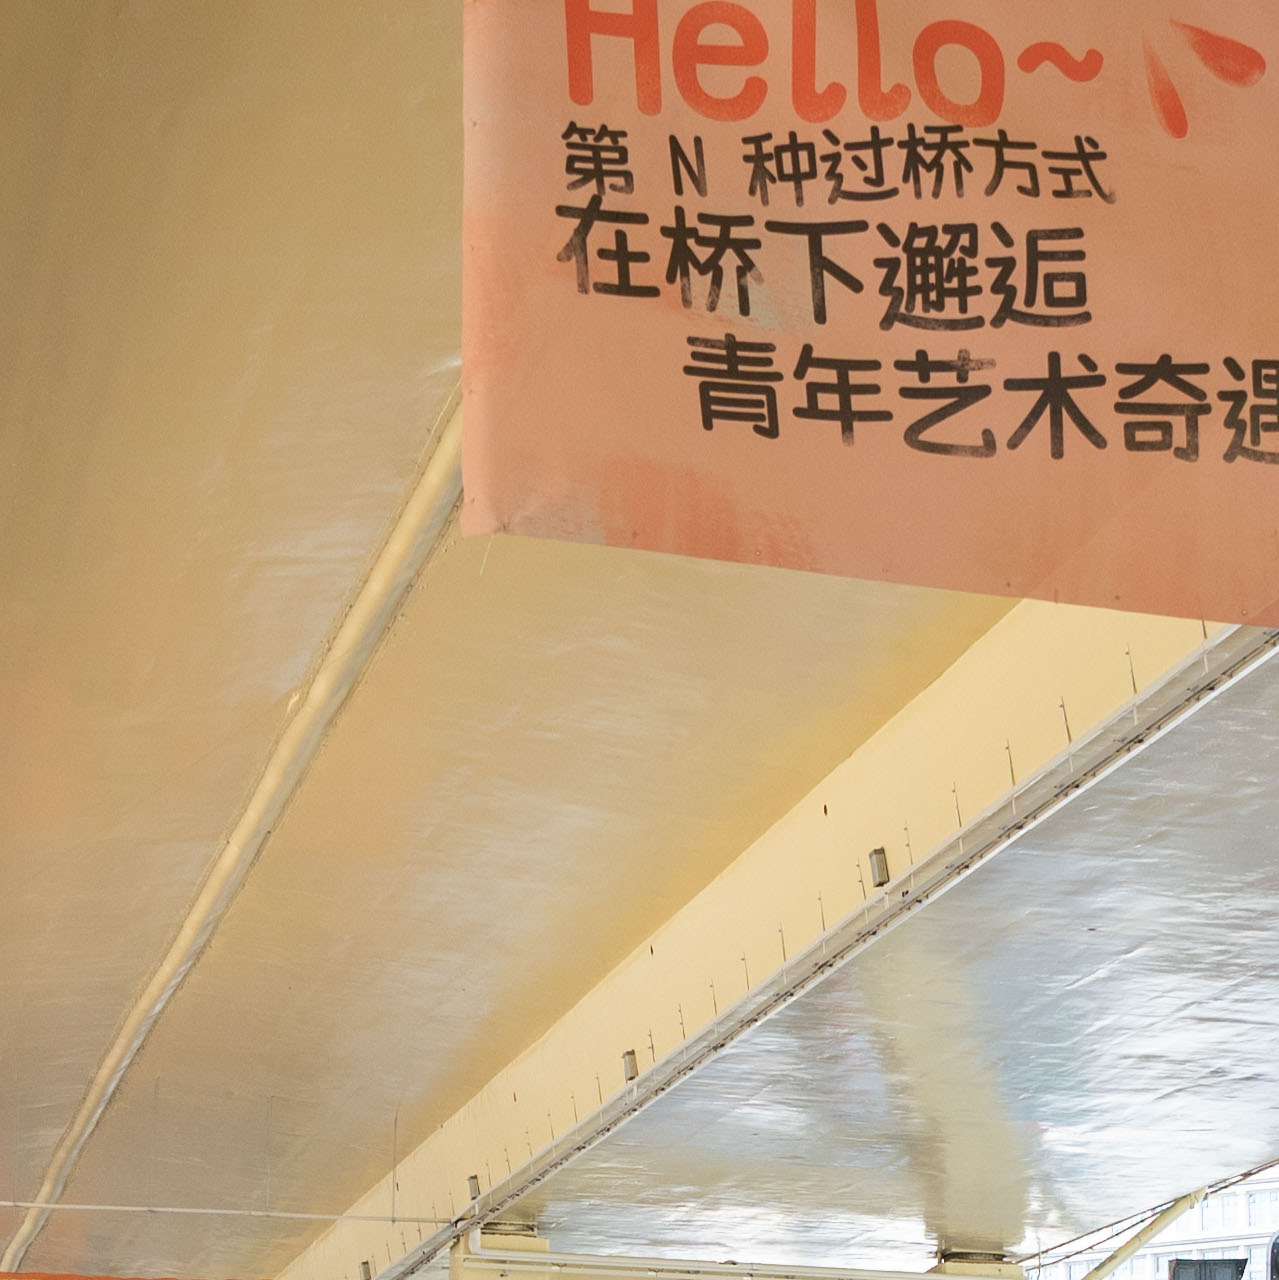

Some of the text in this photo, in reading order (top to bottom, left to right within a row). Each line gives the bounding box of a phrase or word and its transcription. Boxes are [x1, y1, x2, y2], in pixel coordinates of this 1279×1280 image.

[560, 121, 1116, 205] 第 N 种过桥方式
[555, 194, 1092, 331] 在桥下邂逅
